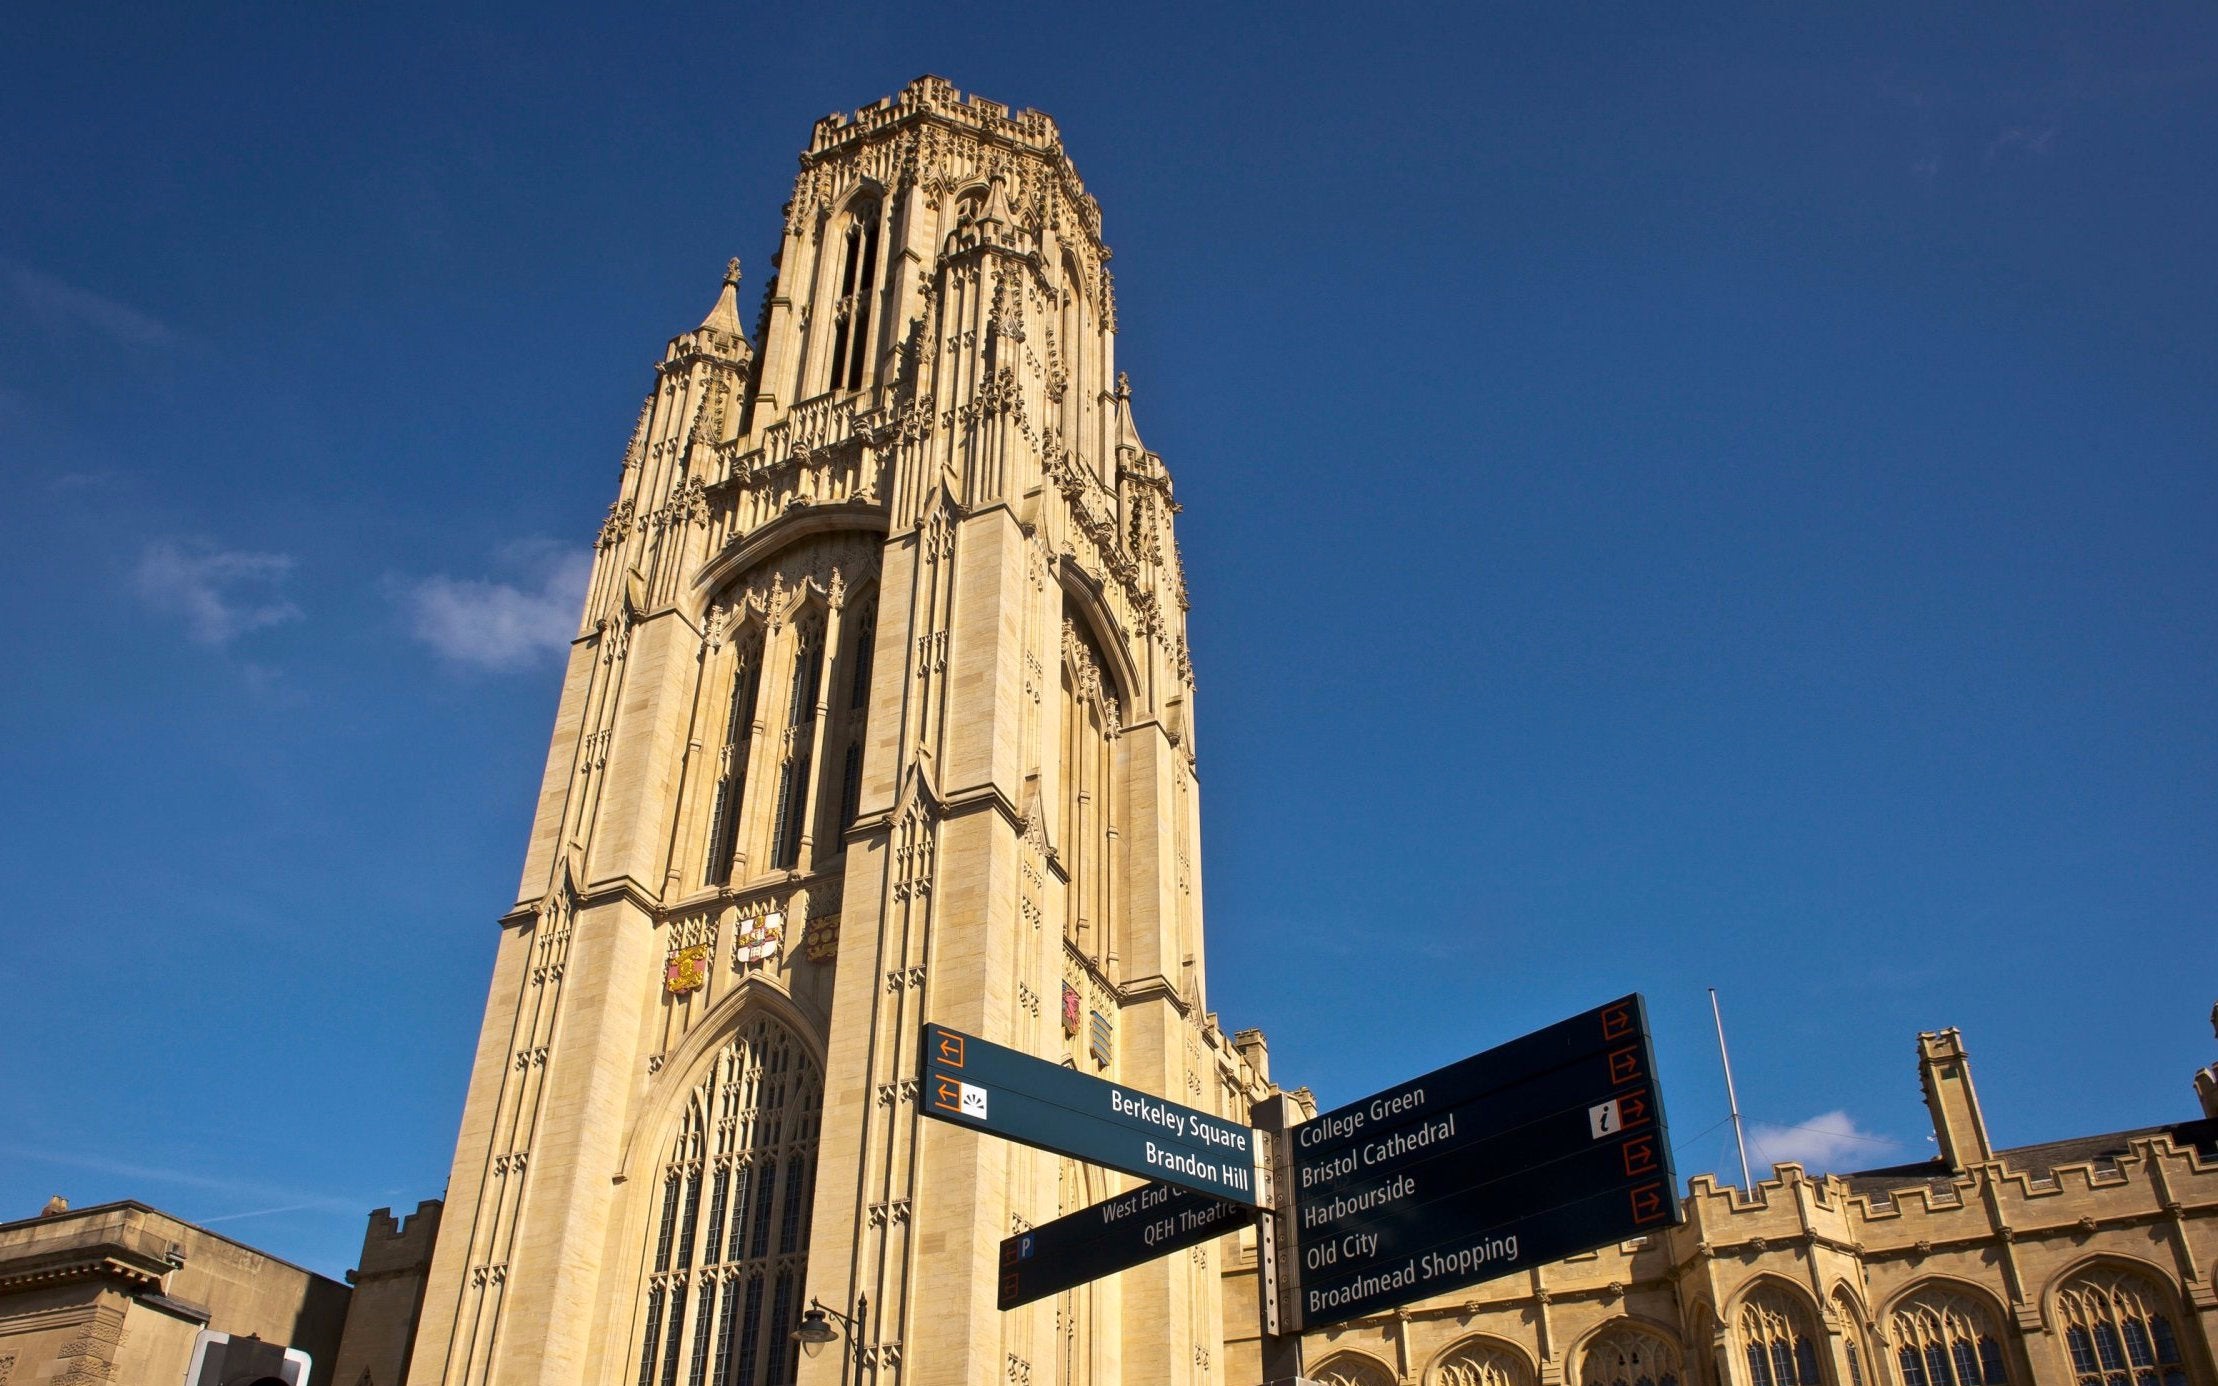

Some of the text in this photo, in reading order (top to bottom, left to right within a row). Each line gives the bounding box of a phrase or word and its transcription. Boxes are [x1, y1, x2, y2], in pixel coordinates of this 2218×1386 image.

[1111, 1089, 1247, 1151] Berkeley Square
[1300, 1088, 1426, 1148] College Green
[1145, 1140, 1249, 1192] Brandon Hill
[1302, 1114, 1456, 1188] Bristol Cathedral
[1102, 1196, 1138, 1224] West
[1141, 1184, 1168, 1209] End
[1144, 1199, 1238, 1246] QEH Theatre
[1304, 1174, 1416, 1229] Harbourside
[1021, 1237, 1030, 1256] P
[1307, 1230, 1379, 1270] Old City
[1309, 1235, 1519, 1312] Broadmead Shopping
